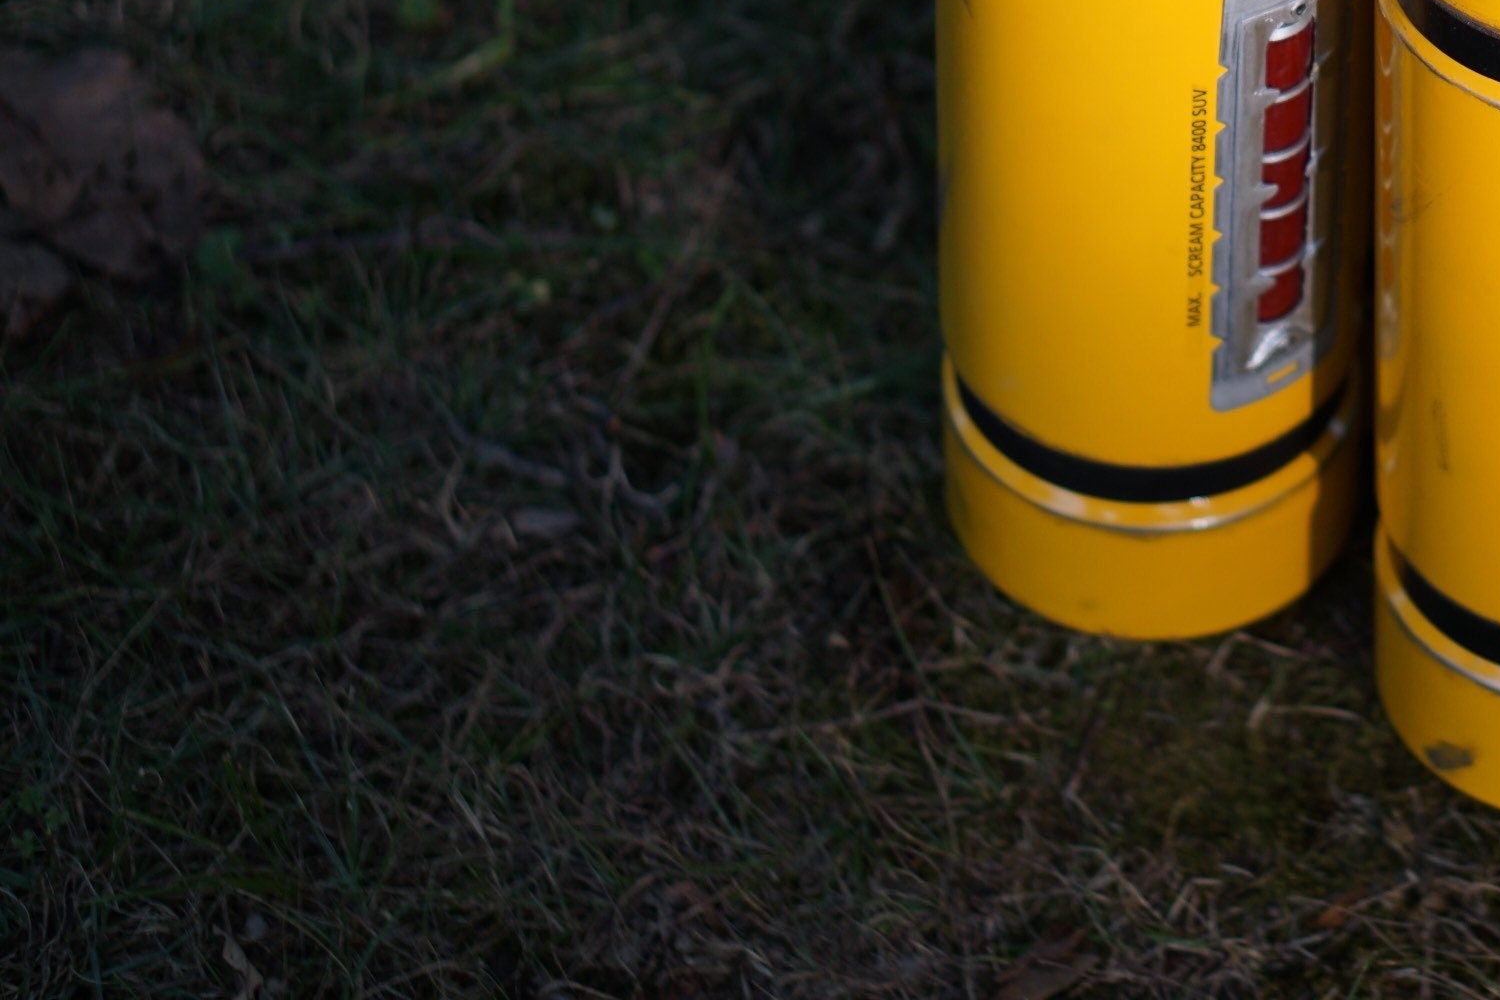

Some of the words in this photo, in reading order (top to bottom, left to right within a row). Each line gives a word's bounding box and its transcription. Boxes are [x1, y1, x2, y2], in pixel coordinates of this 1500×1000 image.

[1192, 89, 1207, 116] SUV
[1191, 120, 1206, 152] 8400
[1190, 157, 1205, 218] CAPACITY
[1188, 222, 1203, 277] SCREAM
[1187, 292, 1202, 327] MAX.
